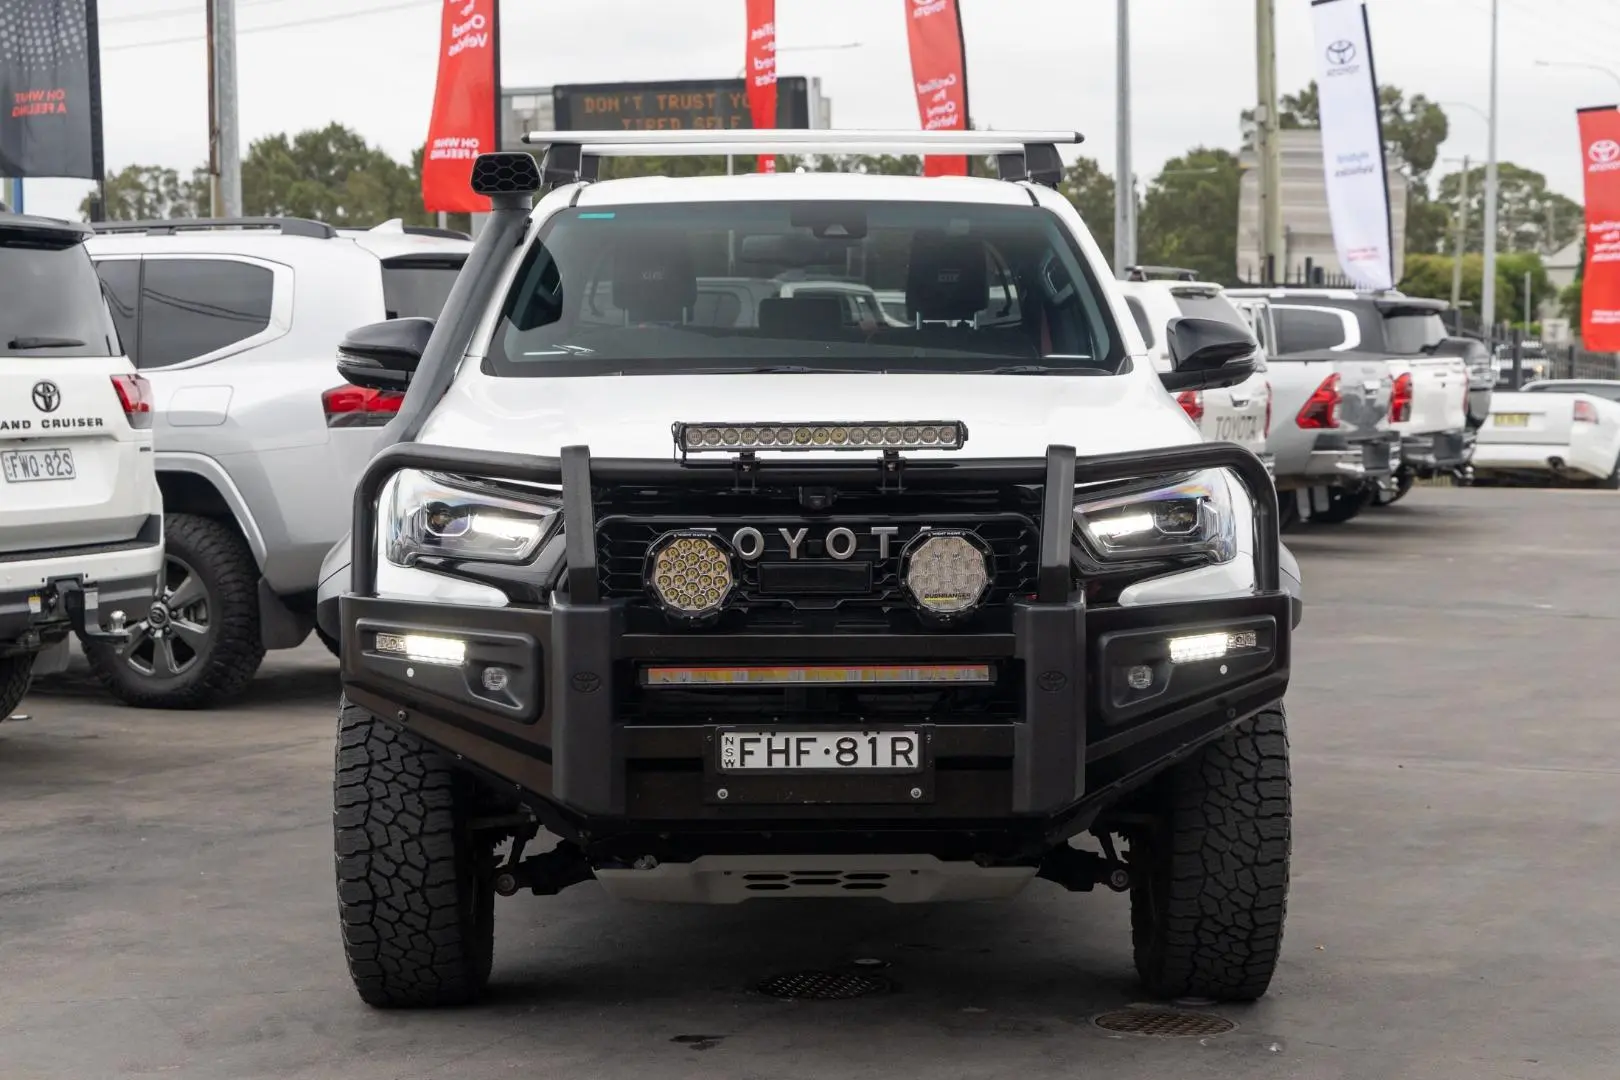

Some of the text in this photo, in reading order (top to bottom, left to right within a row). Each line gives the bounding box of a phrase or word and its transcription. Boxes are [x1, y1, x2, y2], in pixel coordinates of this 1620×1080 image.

[656, 92, 717, 111] TRUST
[41, 417, 103, 428] CRUISER
[1215, 416, 1257, 440] TOYOTA
